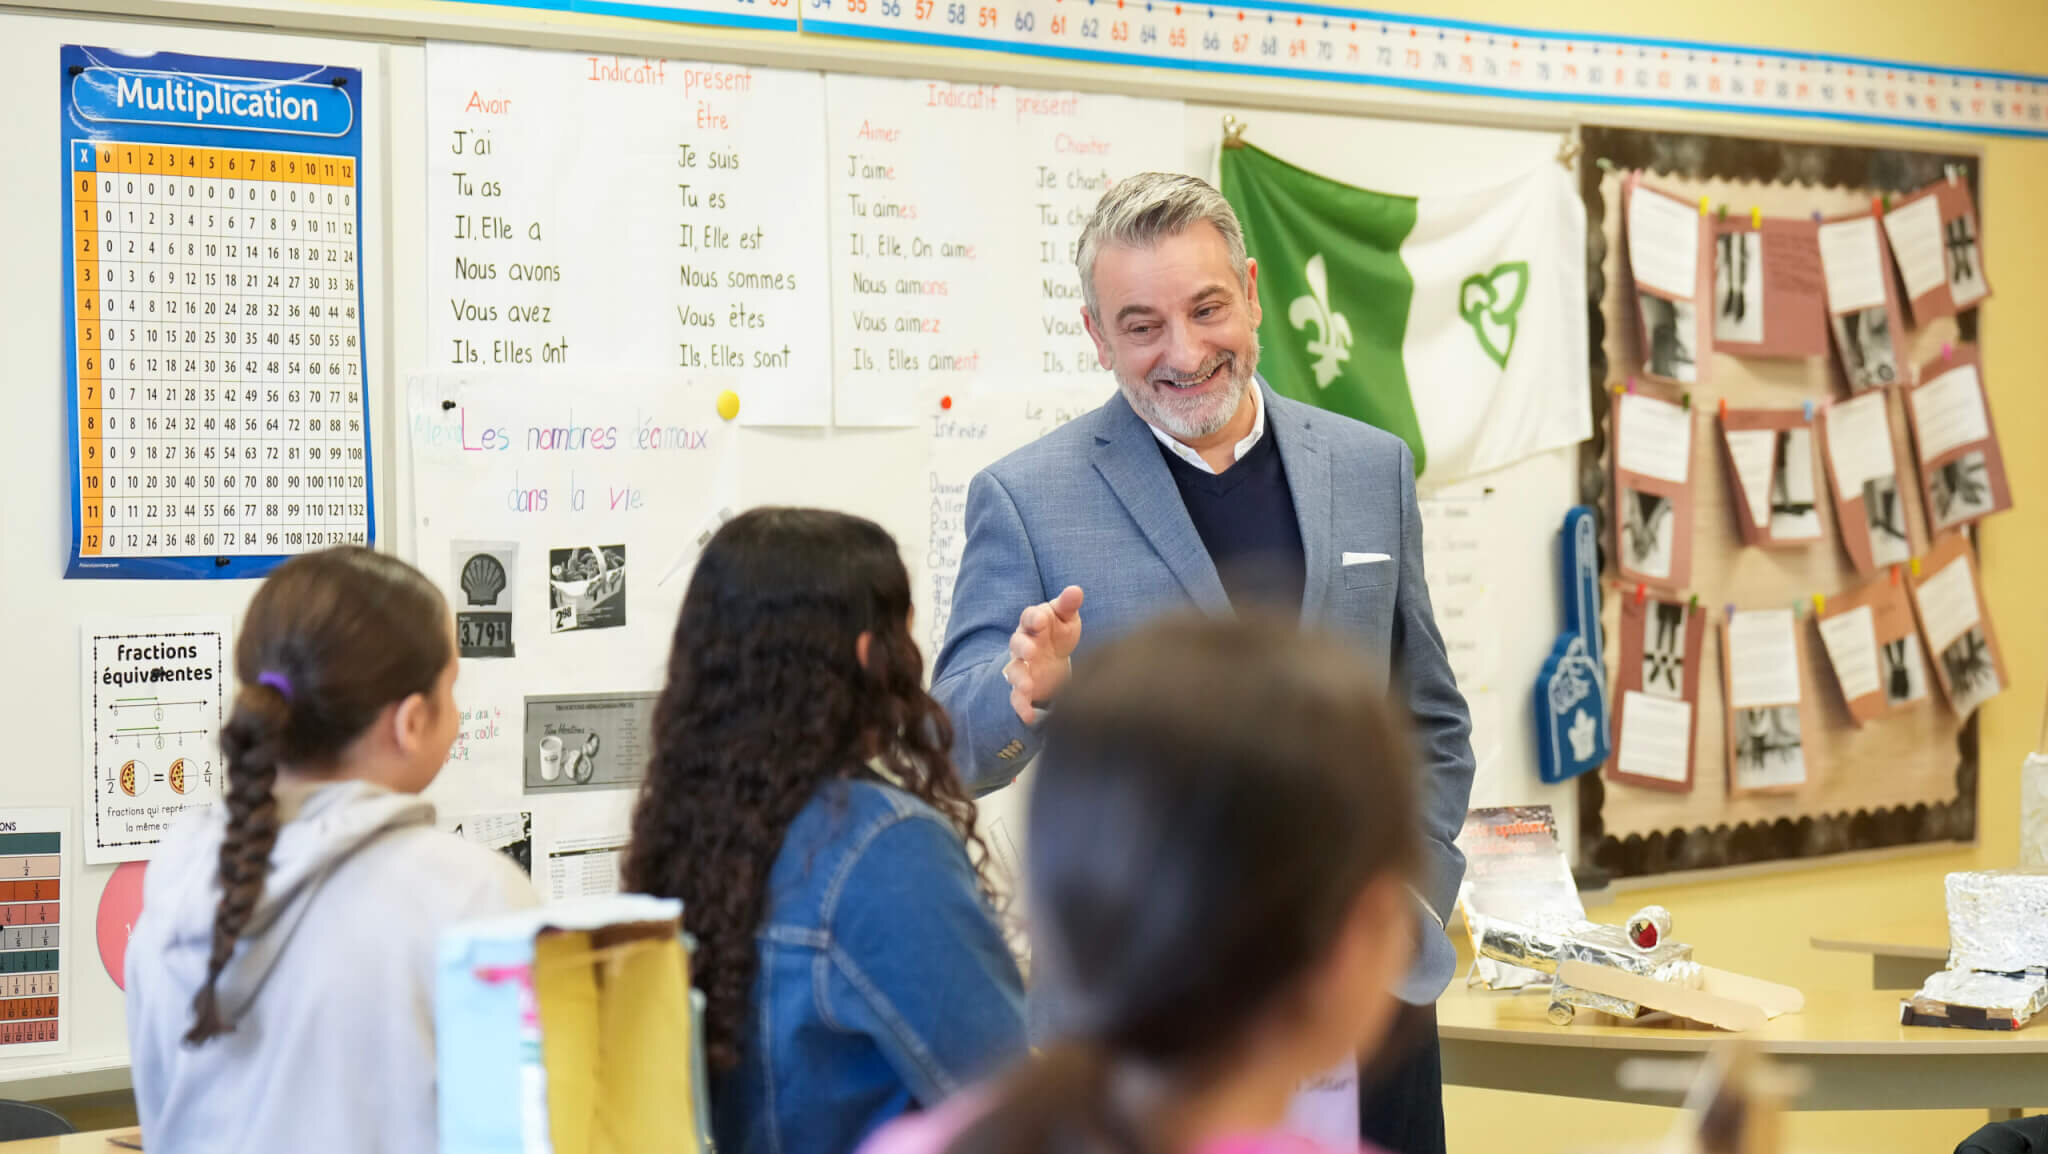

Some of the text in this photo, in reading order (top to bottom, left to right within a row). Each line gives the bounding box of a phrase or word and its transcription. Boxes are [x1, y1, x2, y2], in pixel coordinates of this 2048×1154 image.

[881, 0, 900, 17] 56
[915, 0, 934, 20] 57
[947, 3, 966, 24] 58
[978, 8, 997, 28] 59
[1014, 11, 1034, 32] 60
[1050, 16, 1067, 35] 61
[1081, 17, 1098, 39] 62
[1111, 21, 1128, 41] 63
[1140, 24, 1157, 44] 64
[1168, 28, 1187, 48] 65
[1202, 31, 1220, 51] 66
[587, 56, 667, 85] Indicatif
[117, 78, 318, 122] Multiplication
[465, 90, 511, 115] Avoir
[927, 82, 1000, 111] Indicatif
[697, 100, 729, 130] Être
[451, 128, 491, 155] J'ai
[858, 120, 901, 143] Aimer
[104, 151, 110, 163] 0
[128, 152, 132, 164] 1
[148, 153, 153, 165] 2
[170, 154, 174, 166] 3
[189, 156, 194, 168] 4
[210, 157, 214, 168] 5
[229, 158, 234, 170] 6
[250, 159, 255, 170] 7
[270, 160, 276, 172] 8
[290, 162, 294, 173] 9
[306, 163, 315, 175] 10
[325, 165, 333, 176] 11
[342, 166, 350, 178] 12
[678, 144, 739, 169] Je suis
[82, 180, 88, 192] 0
[452, 172, 501, 197] Tu as
[1036, 166, 1056, 189] Je
[679, 184, 726, 209] Tu es
[848, 193, 918, 219] Tu aimes
[84, 210, 88, 222] 1
[1036, 204, 1058, 225] Tu
[482, 216, 513, 239] Elle
[528, 222, 541, 241] a
[704, 225, 729, 248] Elle
[739, 224, 764, 249] est
[84, 240, 89, 252] 2
[912, 236, 932, 257] On
[456, 256, 560, 281] Nous avons
[680, 264, 796, 290] Nous sommes
[853, 272, 948, 296] Nous aimons
[451, 298, 551, 323] Vous avez
[677, 305, 715, 328] Vous
[852, 311, 940, 333] Vous aimez
[86, 328, 356, 347] 5 0 5 10 15 20 25 30 35 40 45 50 55 60
[494, 340, 532, 363] Elles
[711, 344, 744, 368] Elles
[753, 344, 791, 368] sont
[888, 348, 919, 371] Elles
[929, 349, 979, 371] aiment
[461, 407, 509, 451] Les
[527, 408, 617, 451] nombres
[89, 446, 362, 460] 9 0 9 18 27 36 45 54 63 72 81 90 99 108
[508, 469, 548, 512] dans
[571, 468, 585, 512] la
[461, 623, 495, 647] 3.79
[118, 642, 198, 661] fractions
[107, 805, 145, 817] fractions
[126, 823, 133, 832] la
[136, 822, 160, 832] même
